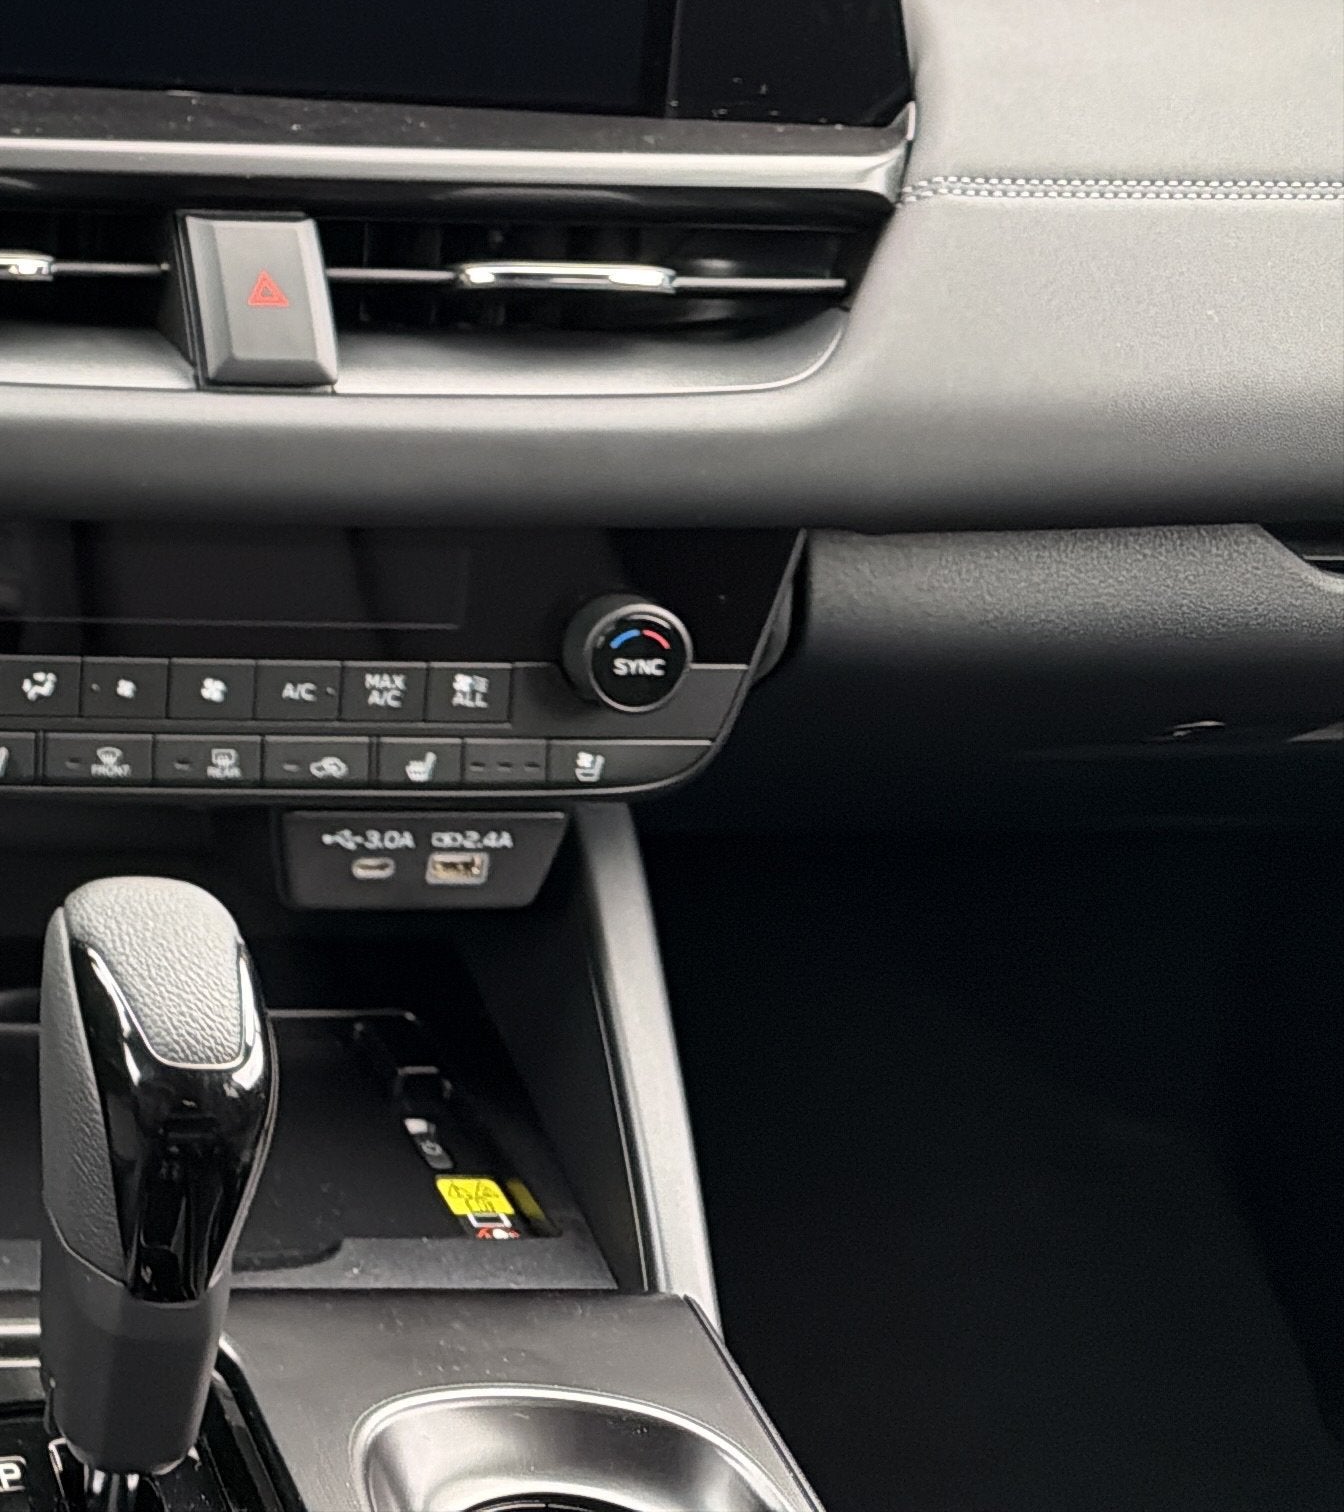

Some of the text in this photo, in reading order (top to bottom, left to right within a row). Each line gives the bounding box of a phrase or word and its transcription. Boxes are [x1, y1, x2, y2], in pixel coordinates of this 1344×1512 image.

[613, 657, 666, 677] SYNC
[364, 672, 407, 690] MAX
[281, 682, 318, 702] A/C
[368, 689, 403, 708] A/C
[451, 691, 489, 708] ALL
